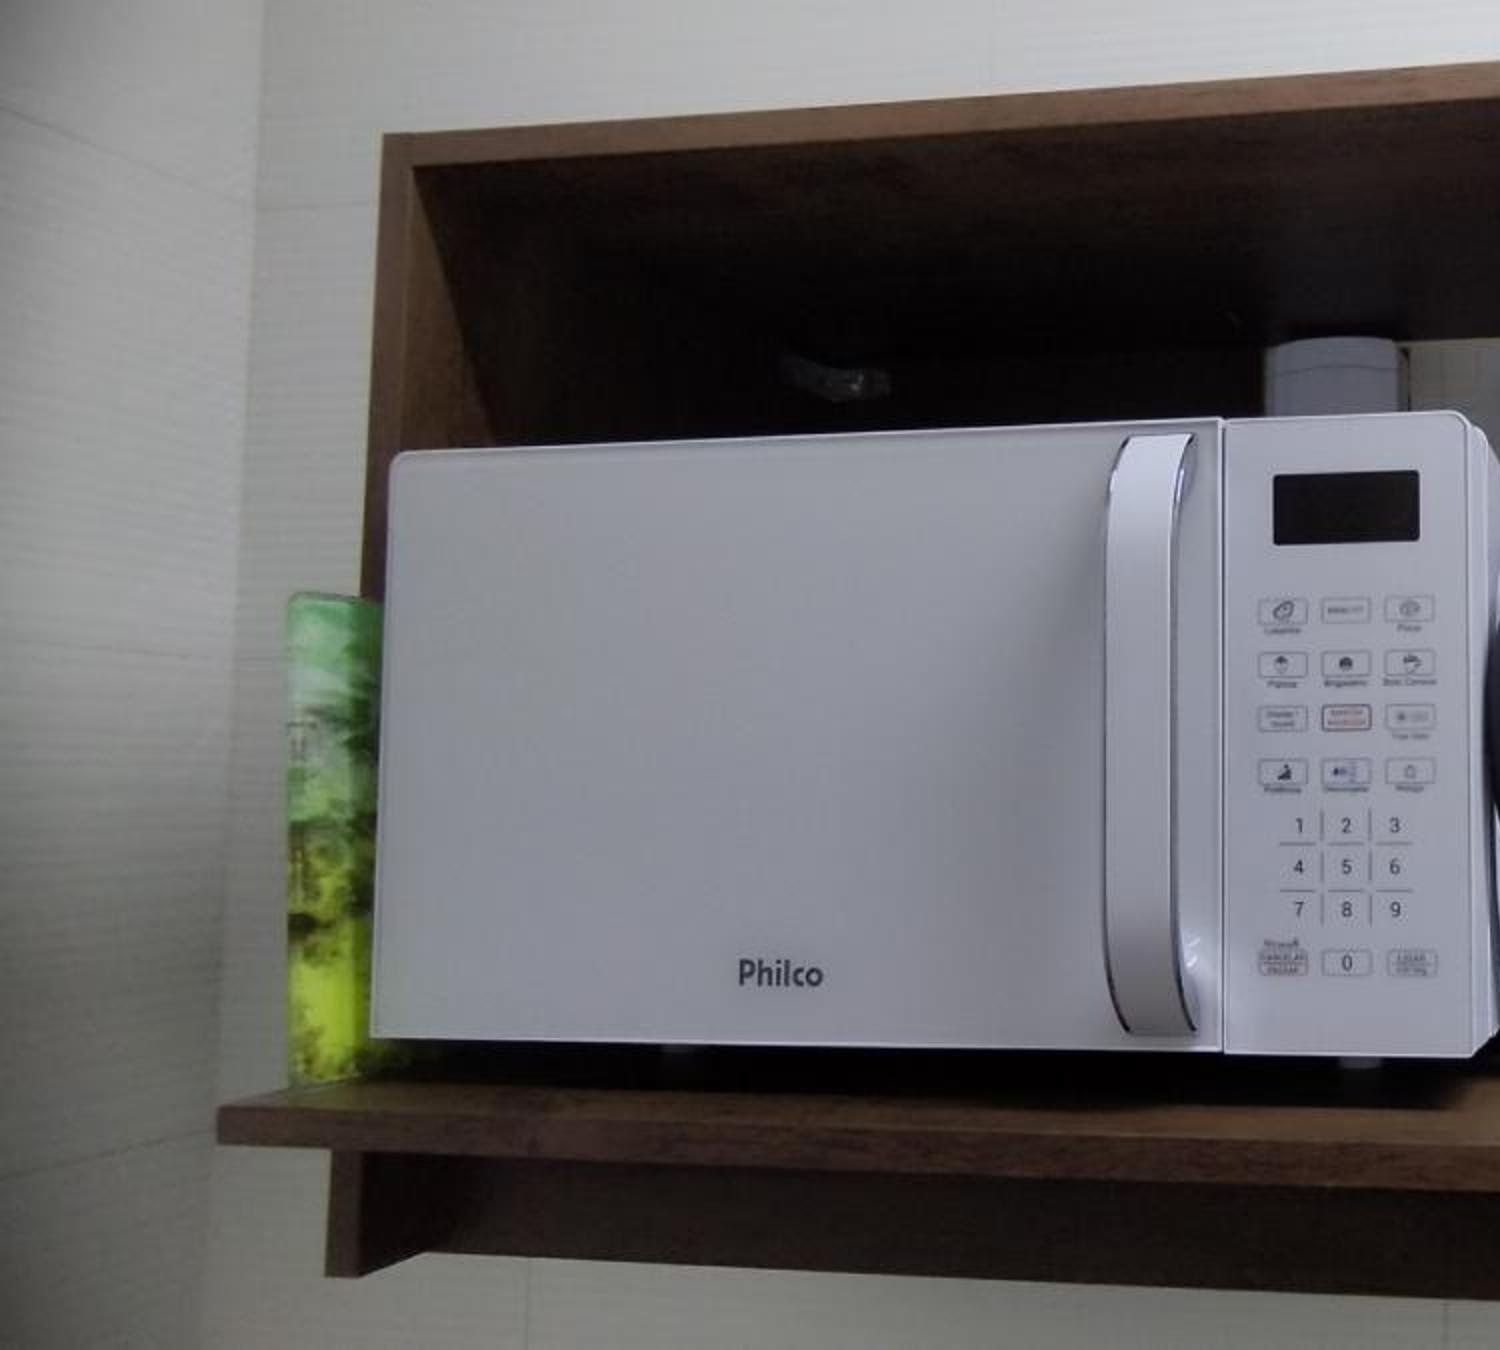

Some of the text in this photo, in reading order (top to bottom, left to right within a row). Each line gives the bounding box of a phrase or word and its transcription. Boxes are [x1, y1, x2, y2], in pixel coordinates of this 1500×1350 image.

[1295, 817, 1401, 834] 1 2 3
[1293, 858, 1401, 875] 4 5 6
[1294, 901, 1401, 918] 7 8 9
[1341, 954, 1353, 973] 0
[738, 958, 824, 987] Philco
